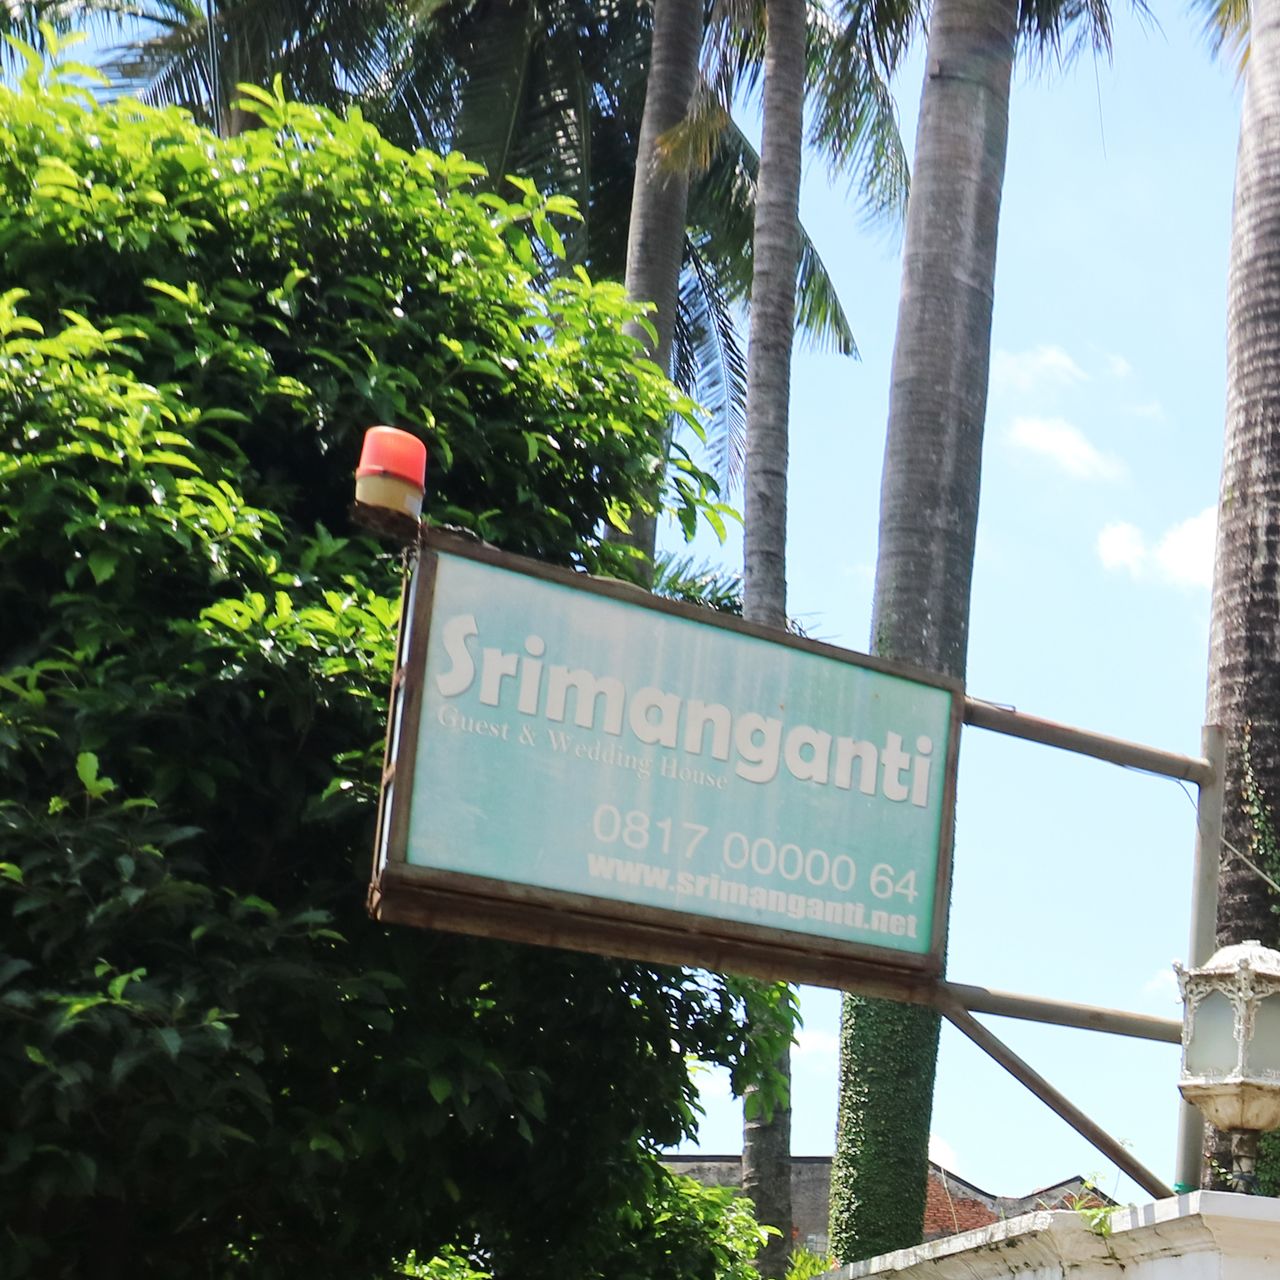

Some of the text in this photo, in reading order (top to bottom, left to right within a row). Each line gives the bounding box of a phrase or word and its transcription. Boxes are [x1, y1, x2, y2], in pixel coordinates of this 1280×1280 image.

[436, 614, 934, 808] Srimanganti
[437, 703, 729, 791] Guest & Wedding House
[587, 853, 918, 939] www.srimanganti.net
[592, 804, 919, 904] 0817 00000 64
